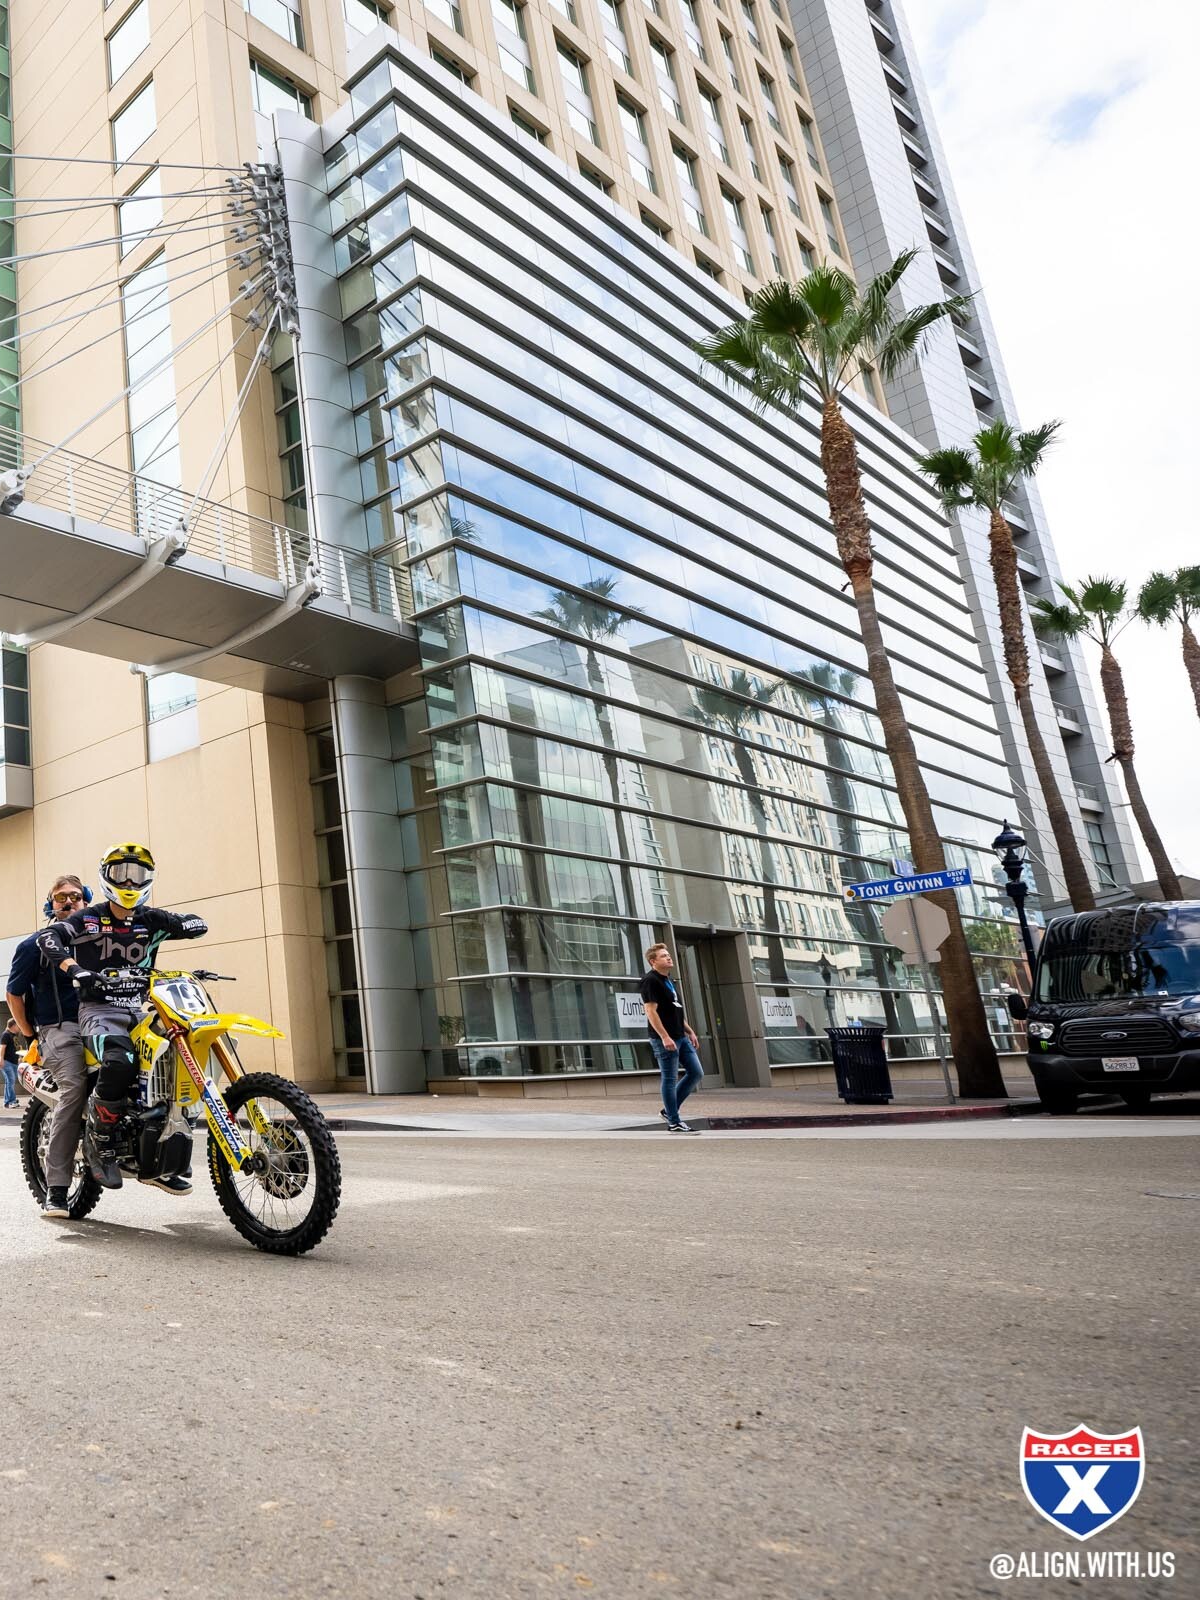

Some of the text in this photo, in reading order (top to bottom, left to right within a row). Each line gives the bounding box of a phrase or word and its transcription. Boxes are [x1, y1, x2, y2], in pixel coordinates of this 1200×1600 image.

[946, 870, 966, 878] DRIVE
[857, 876, 943, 898] TONY GWYNN
[620, 997, 646, 1016] Zumb
[764, 1000, 793, 1017] Zumbido
[141, 1039, 153, 1065] TEA
